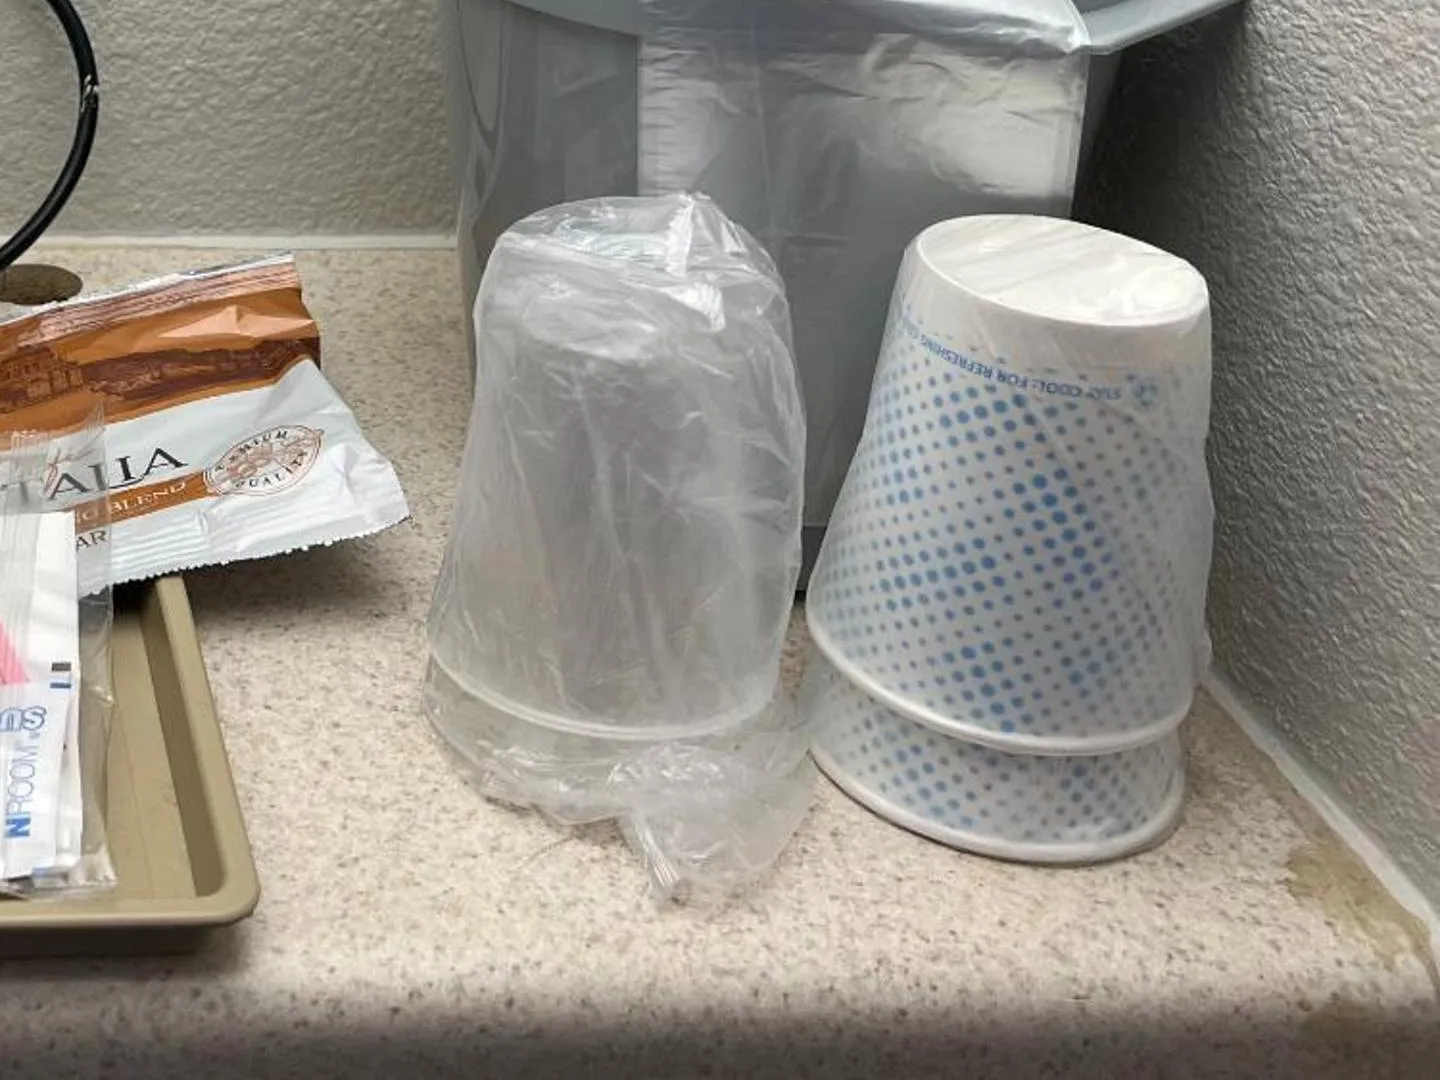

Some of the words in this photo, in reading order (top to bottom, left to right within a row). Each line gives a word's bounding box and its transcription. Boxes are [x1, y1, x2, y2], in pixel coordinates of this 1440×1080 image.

[919, 332, 994, 381] REFRESHING
[996, 370, 1029, 389] FOR
[214, 430, 288, 473] REMIUM
[111, 481, 187, 514] BLEND
